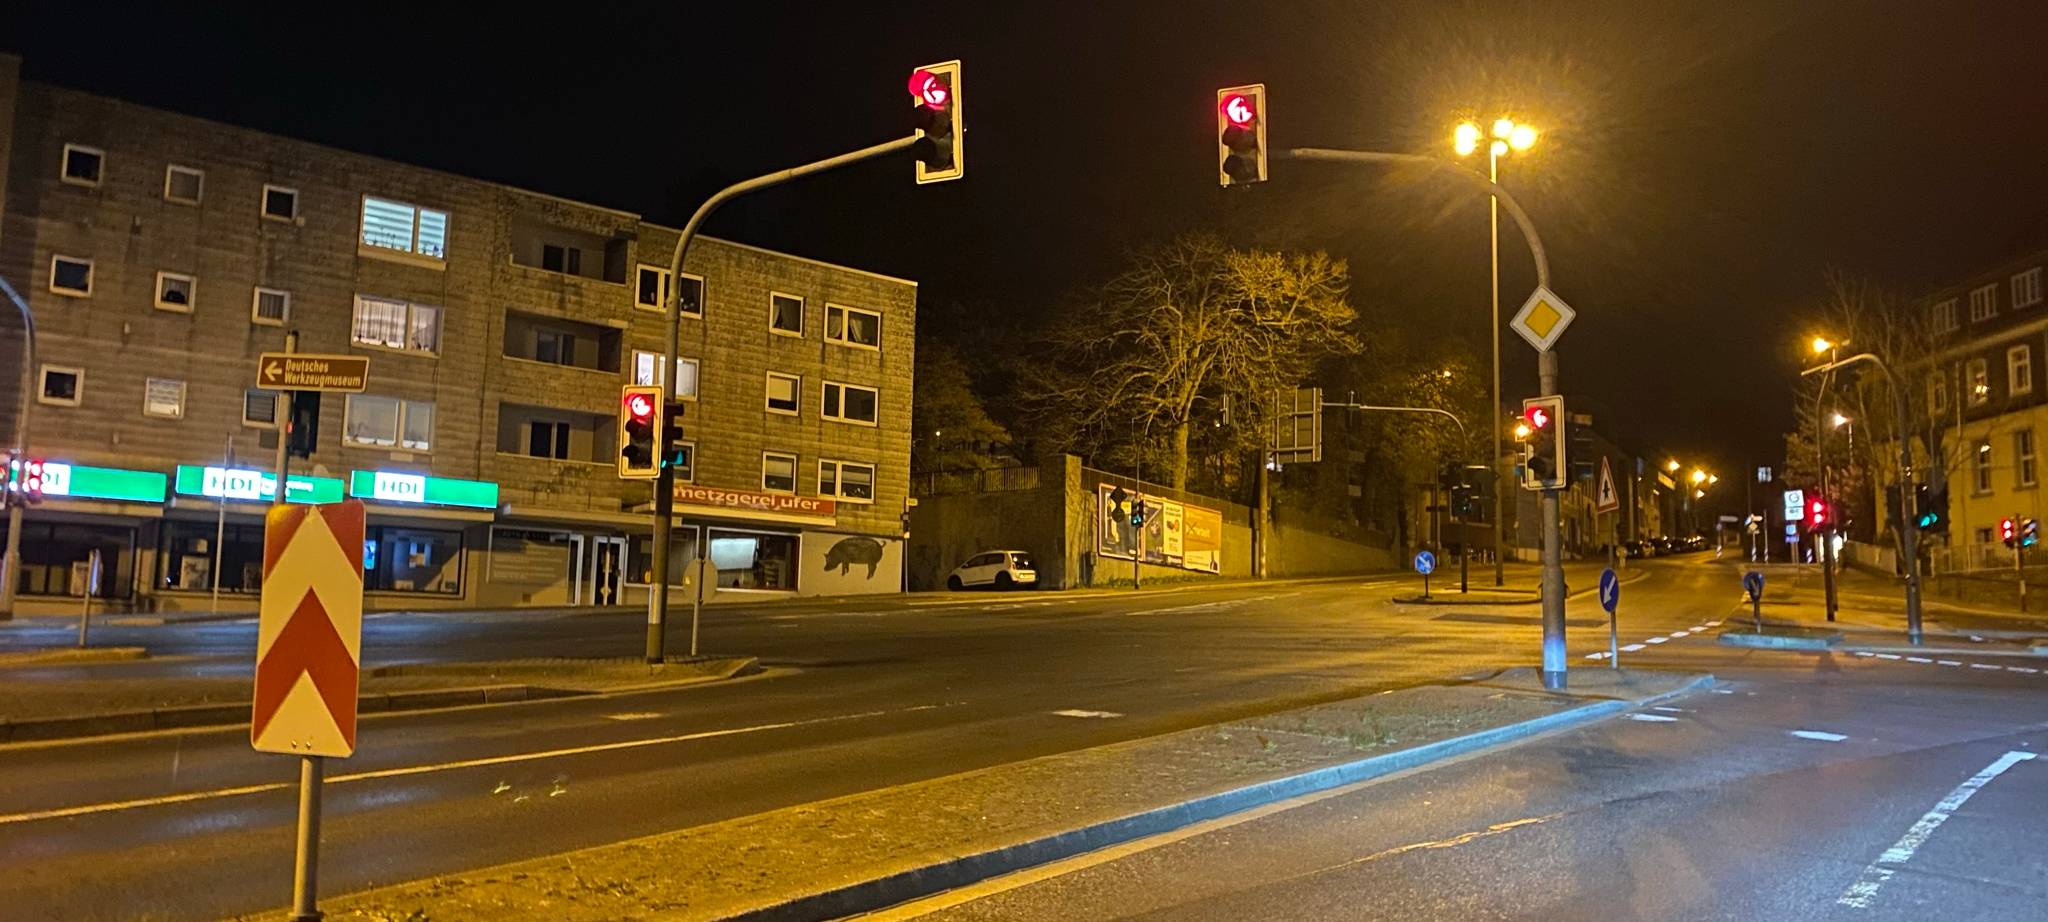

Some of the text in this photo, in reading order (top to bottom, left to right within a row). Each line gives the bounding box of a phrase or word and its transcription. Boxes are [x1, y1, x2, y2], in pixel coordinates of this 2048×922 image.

[285, 358, 329, 373] Deutsches
[284, 371, 361, 388] Werkzeugmuseum
[211, 475, 253, 492] HDI
[381, 480, 418, 495] HDI
